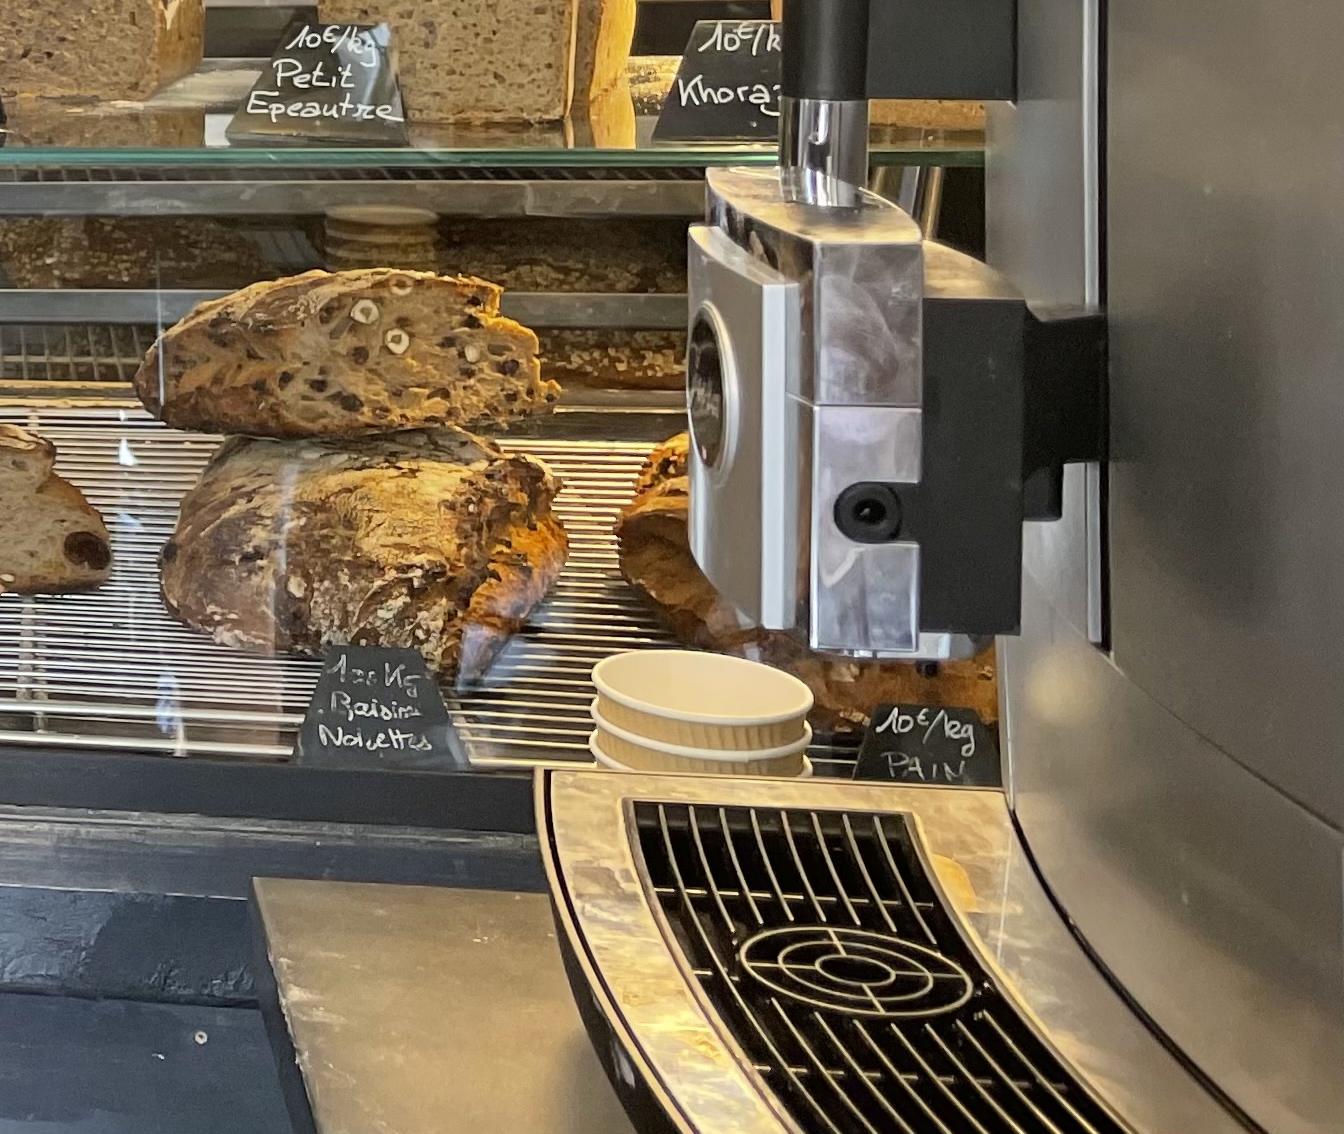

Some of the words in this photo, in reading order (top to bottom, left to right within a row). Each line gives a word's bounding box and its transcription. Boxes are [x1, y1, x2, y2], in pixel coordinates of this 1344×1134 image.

[285, 24, 377, 67] 10€/kg
[273, 58, 356, 89] Petit
[246, 90, 405, 123] Epeautre
[875, 707, 976, 758] 10€/kg
[880, 751, 966, 781] PAIN
